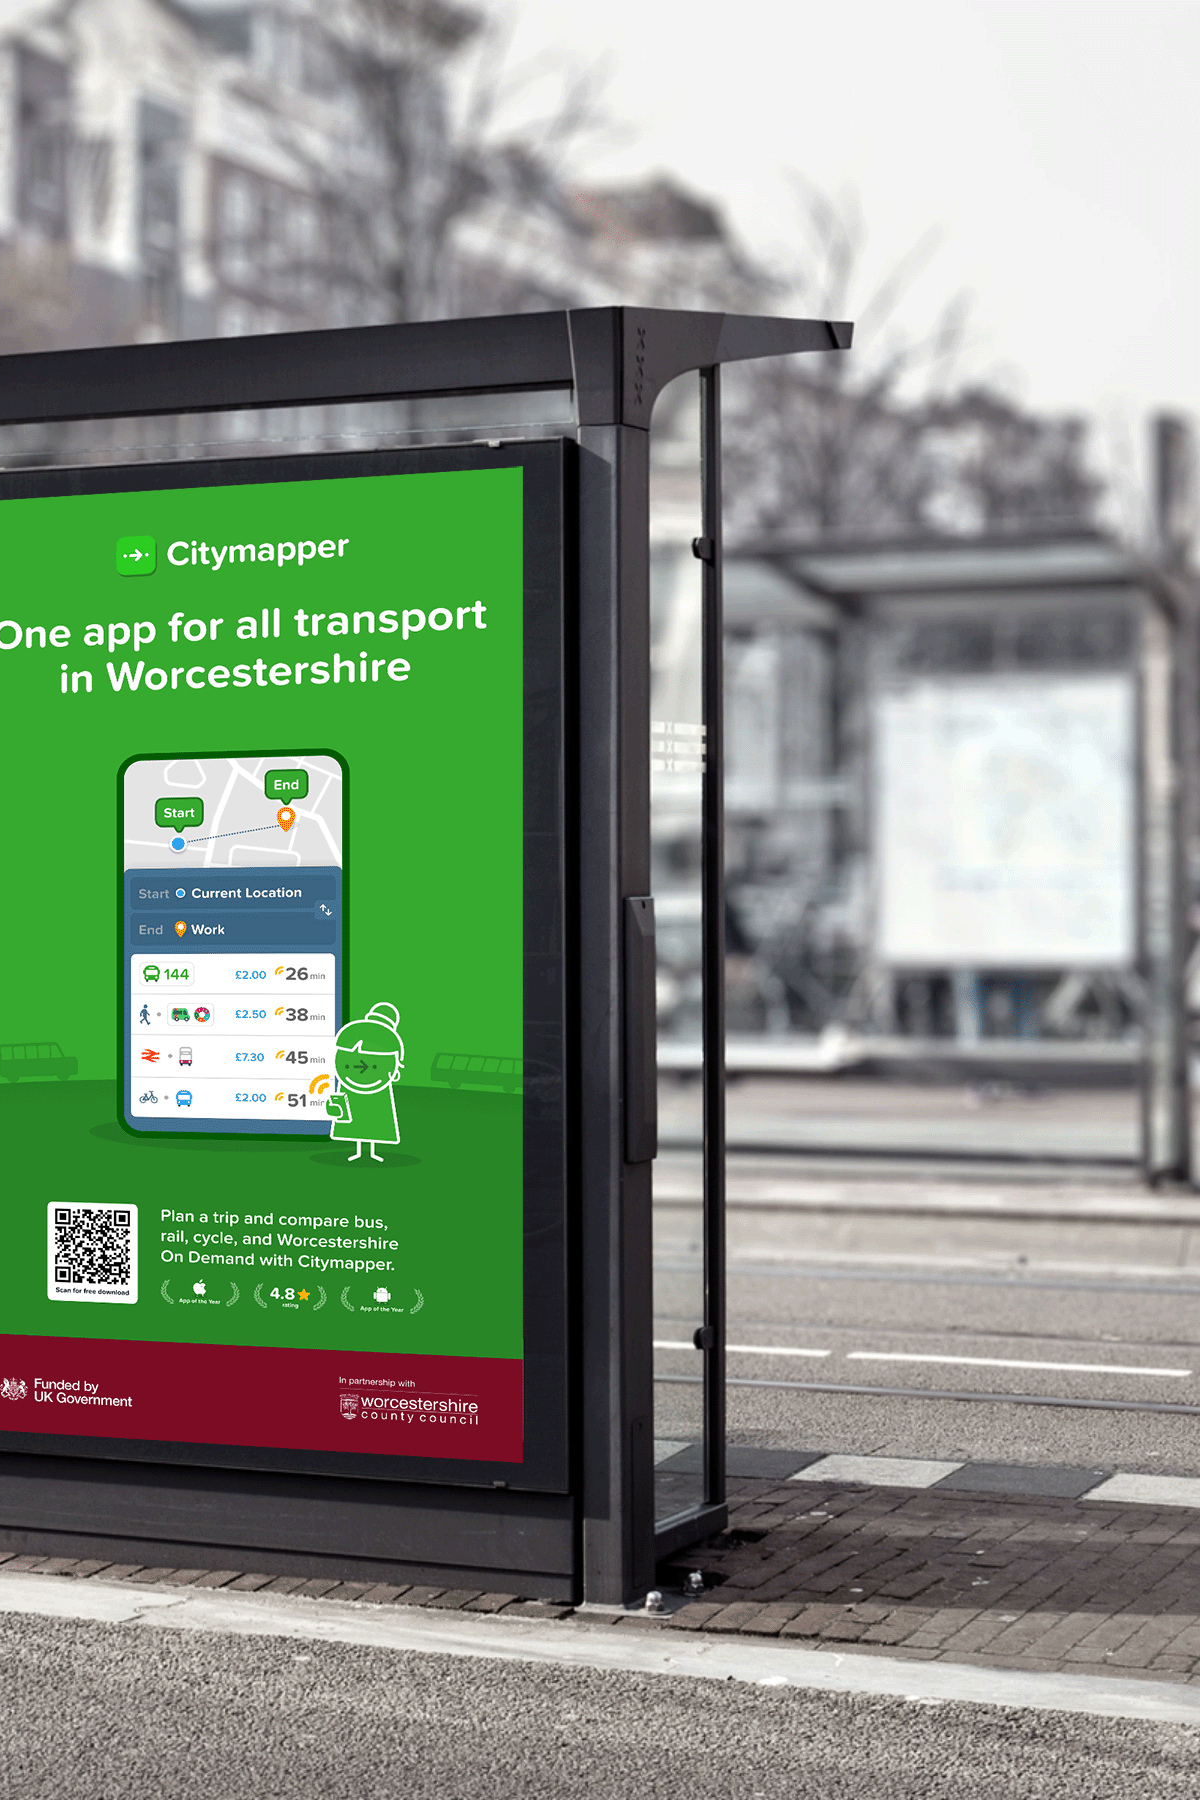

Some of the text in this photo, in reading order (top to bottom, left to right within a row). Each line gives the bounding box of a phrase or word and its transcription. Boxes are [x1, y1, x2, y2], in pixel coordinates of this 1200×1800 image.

[167, 539, 349, 571] Citymapper
[84, 622, 156, 653] app
[168, 612, 224, 642] for
[237, 608, 280, 639] all
[294, 601, 487, 640] transport
[61, 651, 410, 693] in Worcestershire
[274, 779, 299, 790] End
[164, 808, 194, 818] Start
[139, 887, 301, 899] Start Current Location
[139, 924, 224, 935] End Work
[164, 967, 325, 980] 144 £2.00 26 min
[236, 1008, 325, 1021] £2.50 38 min
[236, 1051, 325, 1064] £7.30 45 min
[236, 1092, 266, 1103] £2.00
[288, 1094, 306, 1107] 51
[161, 1209, 388, 1231] Plan a trip and compare bus,
[161, 1230, 398, 1250] rail, cycle, and Worcestershire
[161, 1250, 394, 1273] On Demand with Citymapper.
[270, 1288, 295, 1300] 4.8
[35, 1378, 99, 1394] Funded by
[349, 1377, 395, 1388] partnership
[398, 1379, 415, 1388] with
[35, 1391, 132, 1407] UK Government
[361, 1397, 478, 1413] worcestershire
[361, 1411, 478, 1425] county council
